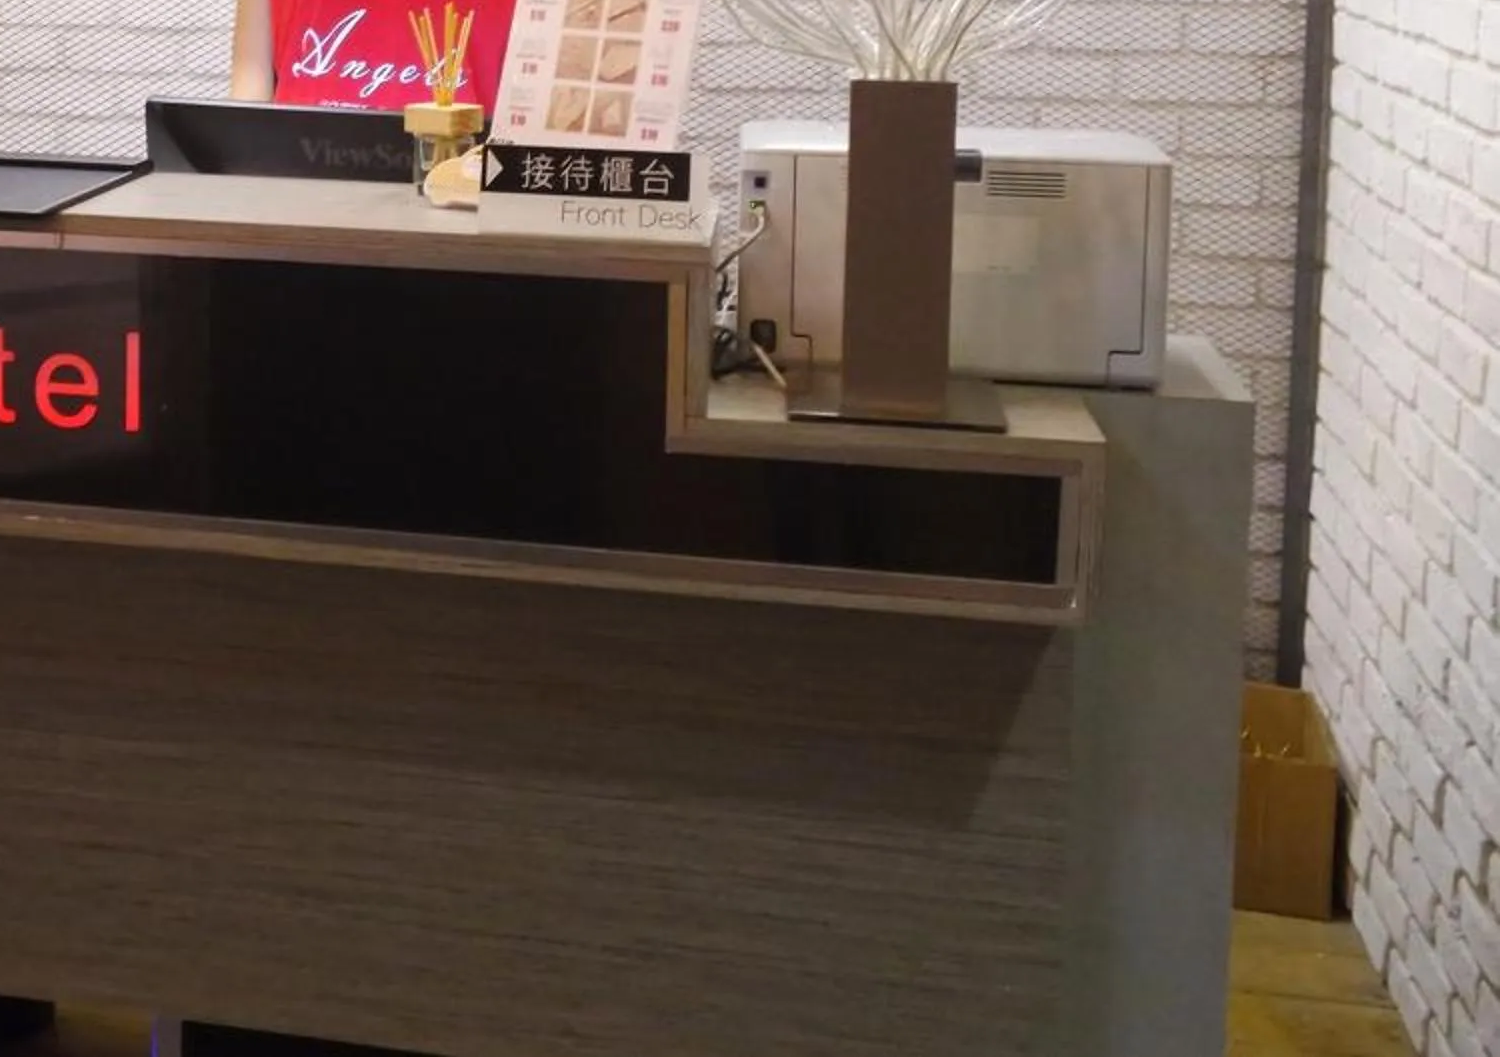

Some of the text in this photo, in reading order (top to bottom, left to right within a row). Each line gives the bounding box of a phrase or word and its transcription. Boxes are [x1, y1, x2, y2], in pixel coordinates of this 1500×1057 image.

[300, 136, 414, 171] ViewSo
[520, 150, 675, 196] 接待櫃台
[560, 199, 701, 231] Front Desk
